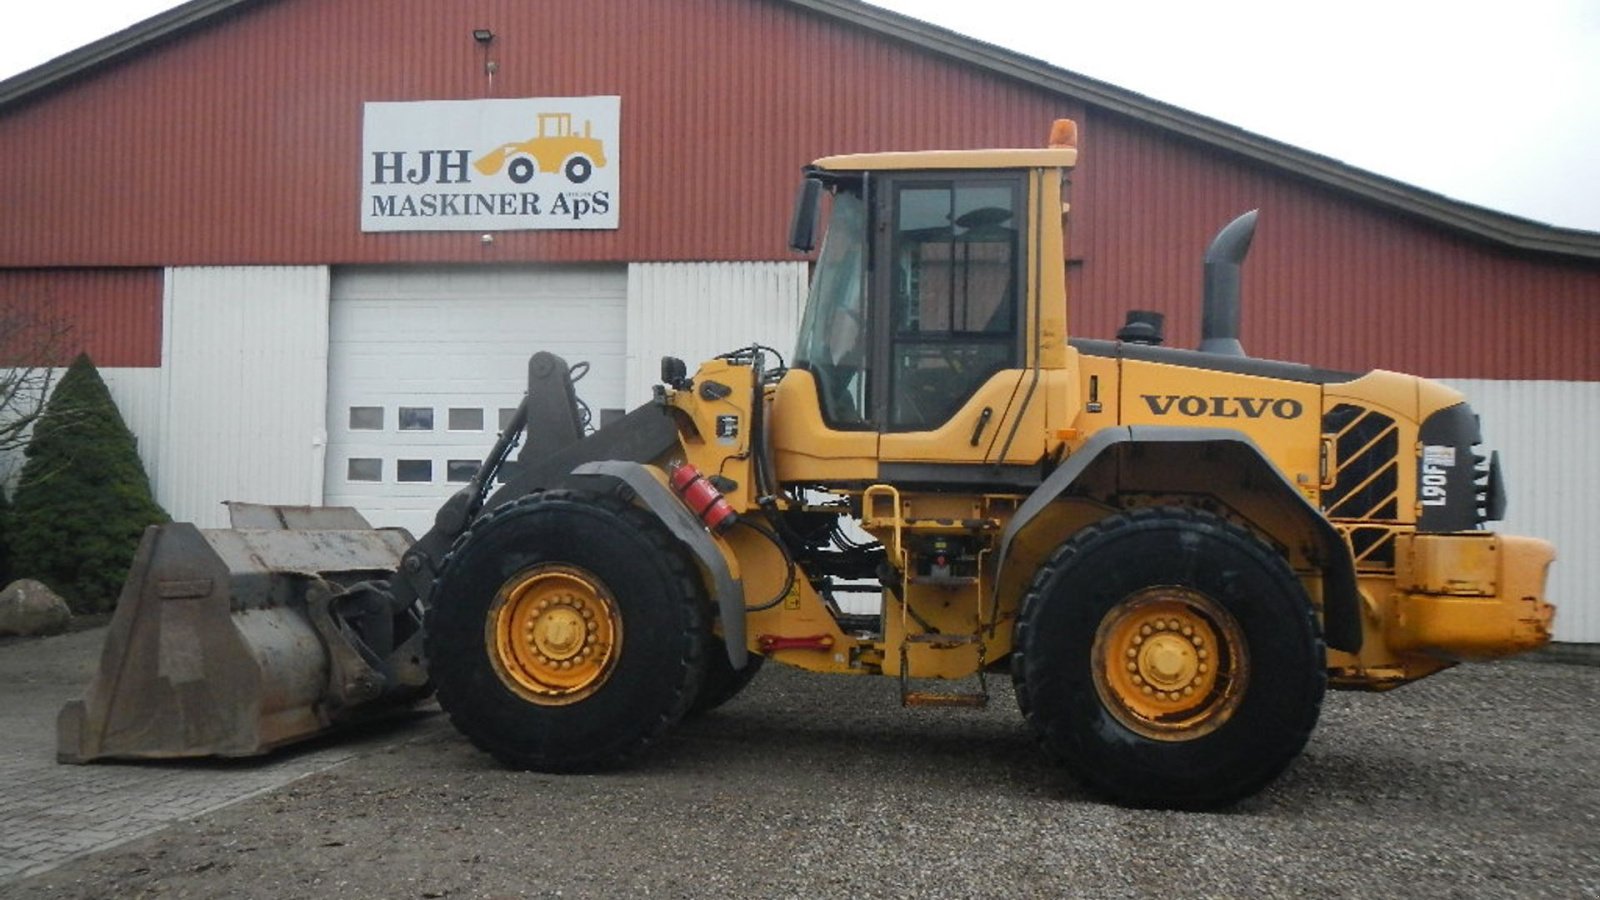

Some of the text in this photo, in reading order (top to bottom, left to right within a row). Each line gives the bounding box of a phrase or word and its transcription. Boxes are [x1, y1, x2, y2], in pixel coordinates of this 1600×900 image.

[370, 150, 472, 185] HJH
[371, 190, 610, 220] MASKINER ApS
[1139, 394, 1304, 420] VOLVO
[1422, 463, 1447, 506] L90F
